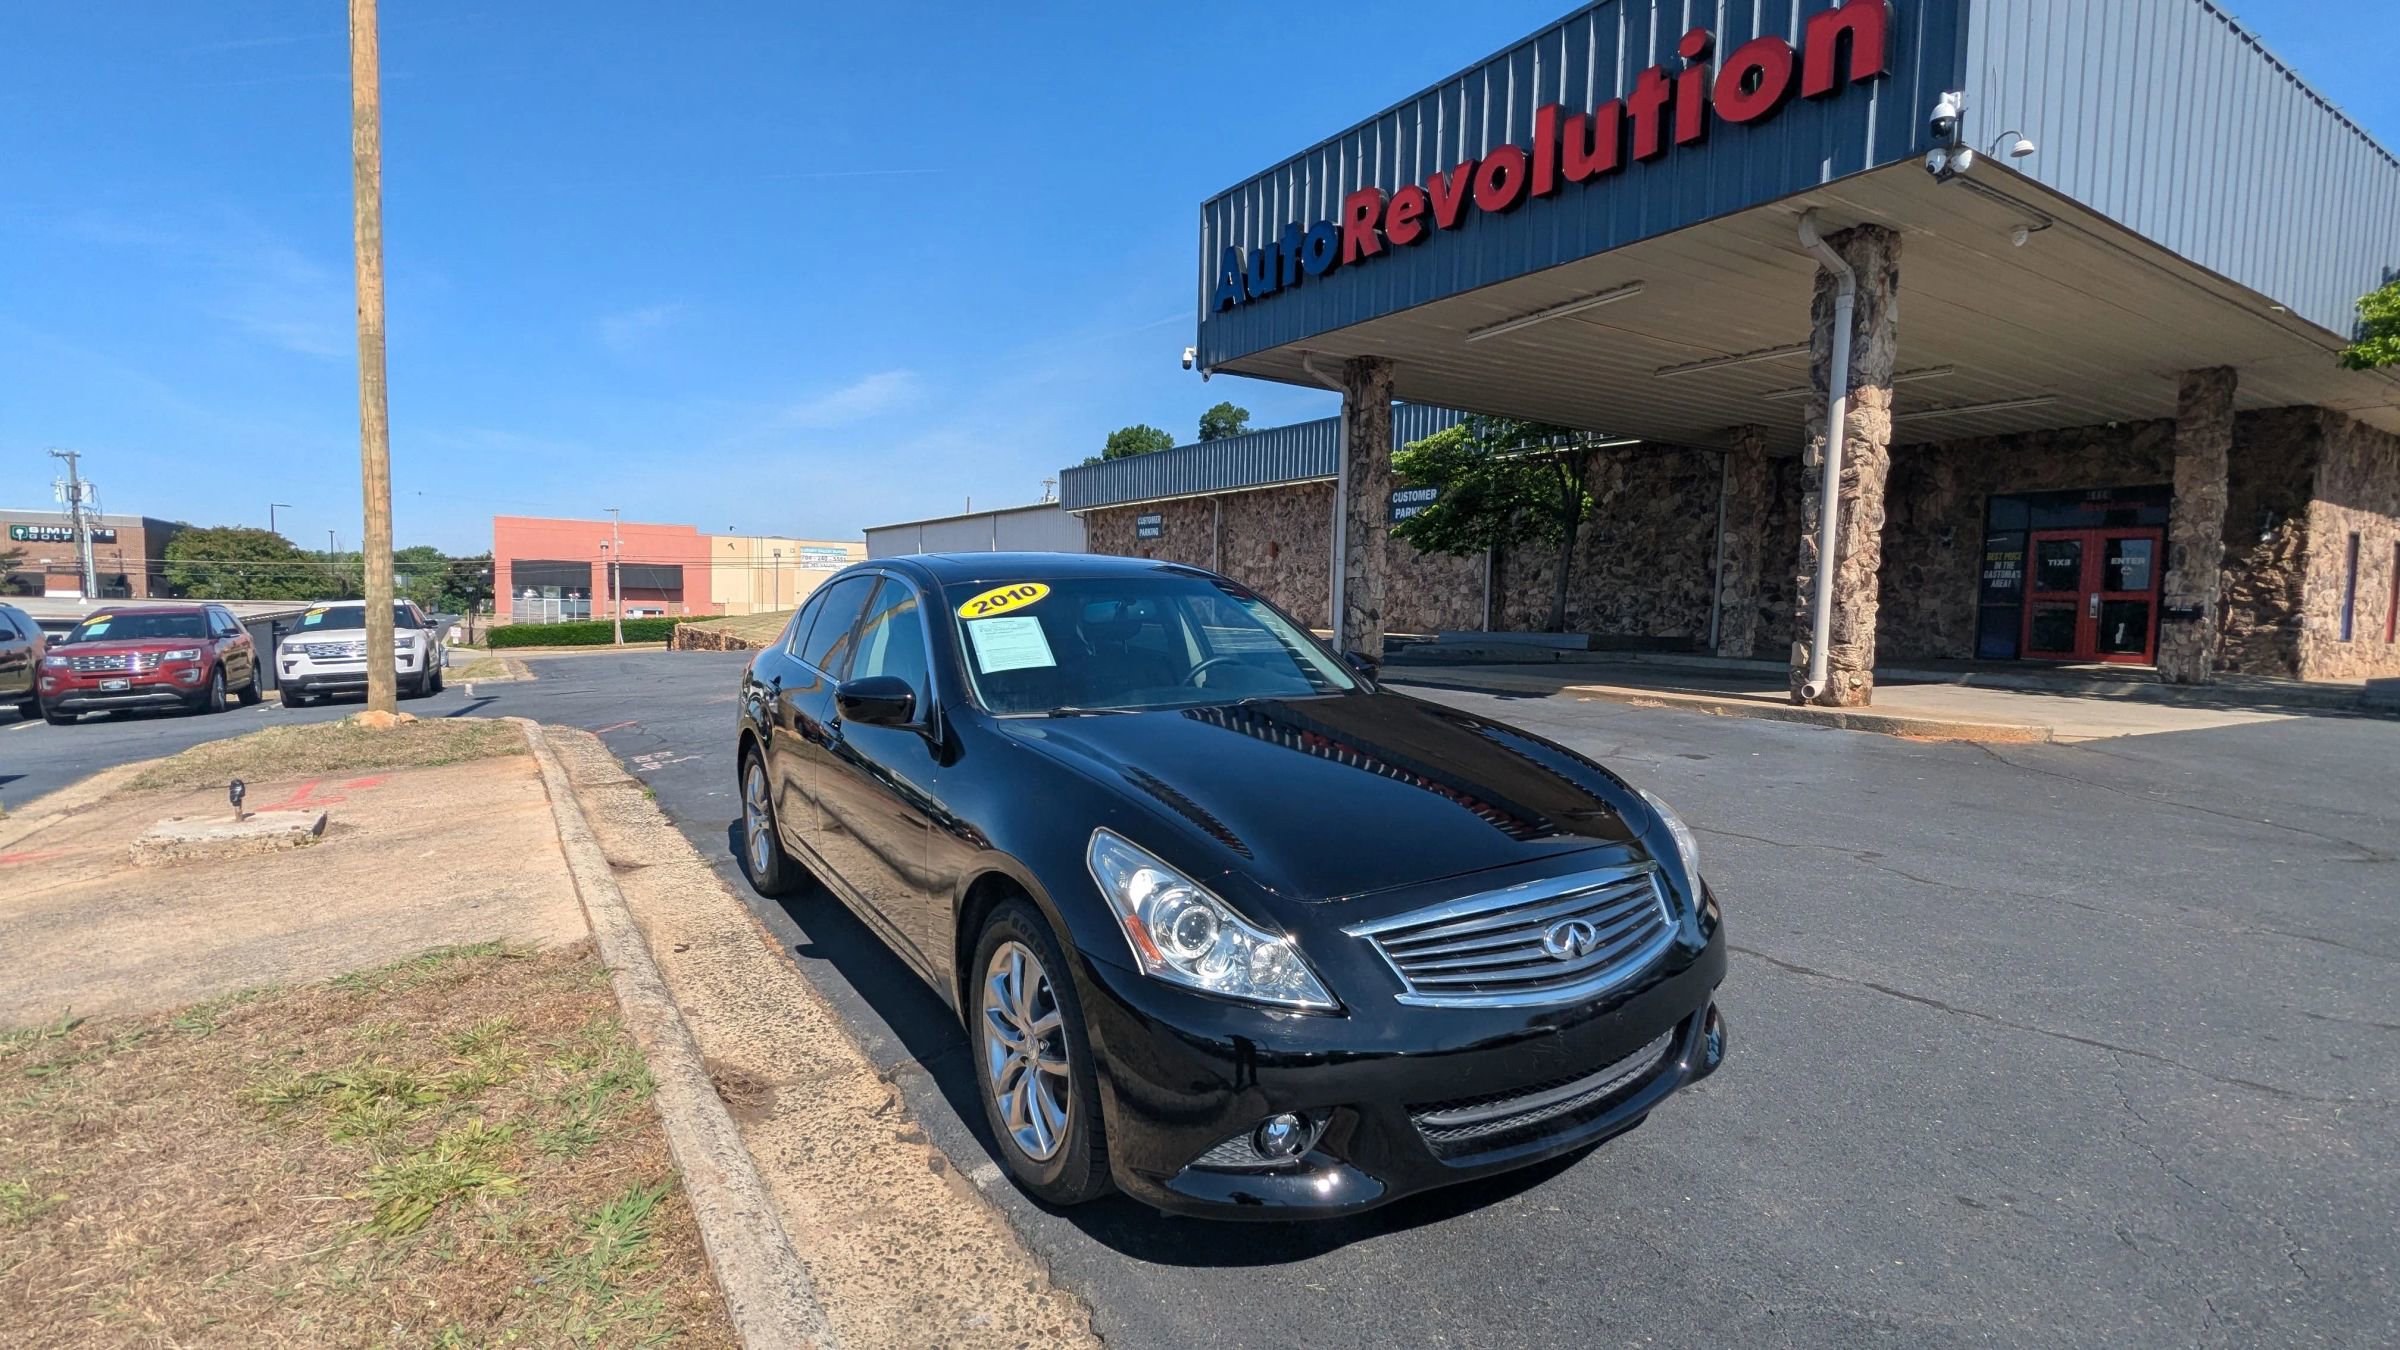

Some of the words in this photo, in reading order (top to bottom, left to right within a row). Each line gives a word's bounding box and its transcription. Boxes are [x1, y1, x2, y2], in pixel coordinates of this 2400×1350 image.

[1392, 488, 1437, 503] CUSTOMER
[28, 526, 115, 537] SIMUTE
[28, 533, 72, 541] GOLF
[2110, 557, 2146, 565] ENTER
[971, 585, 1037, 615] 2010
